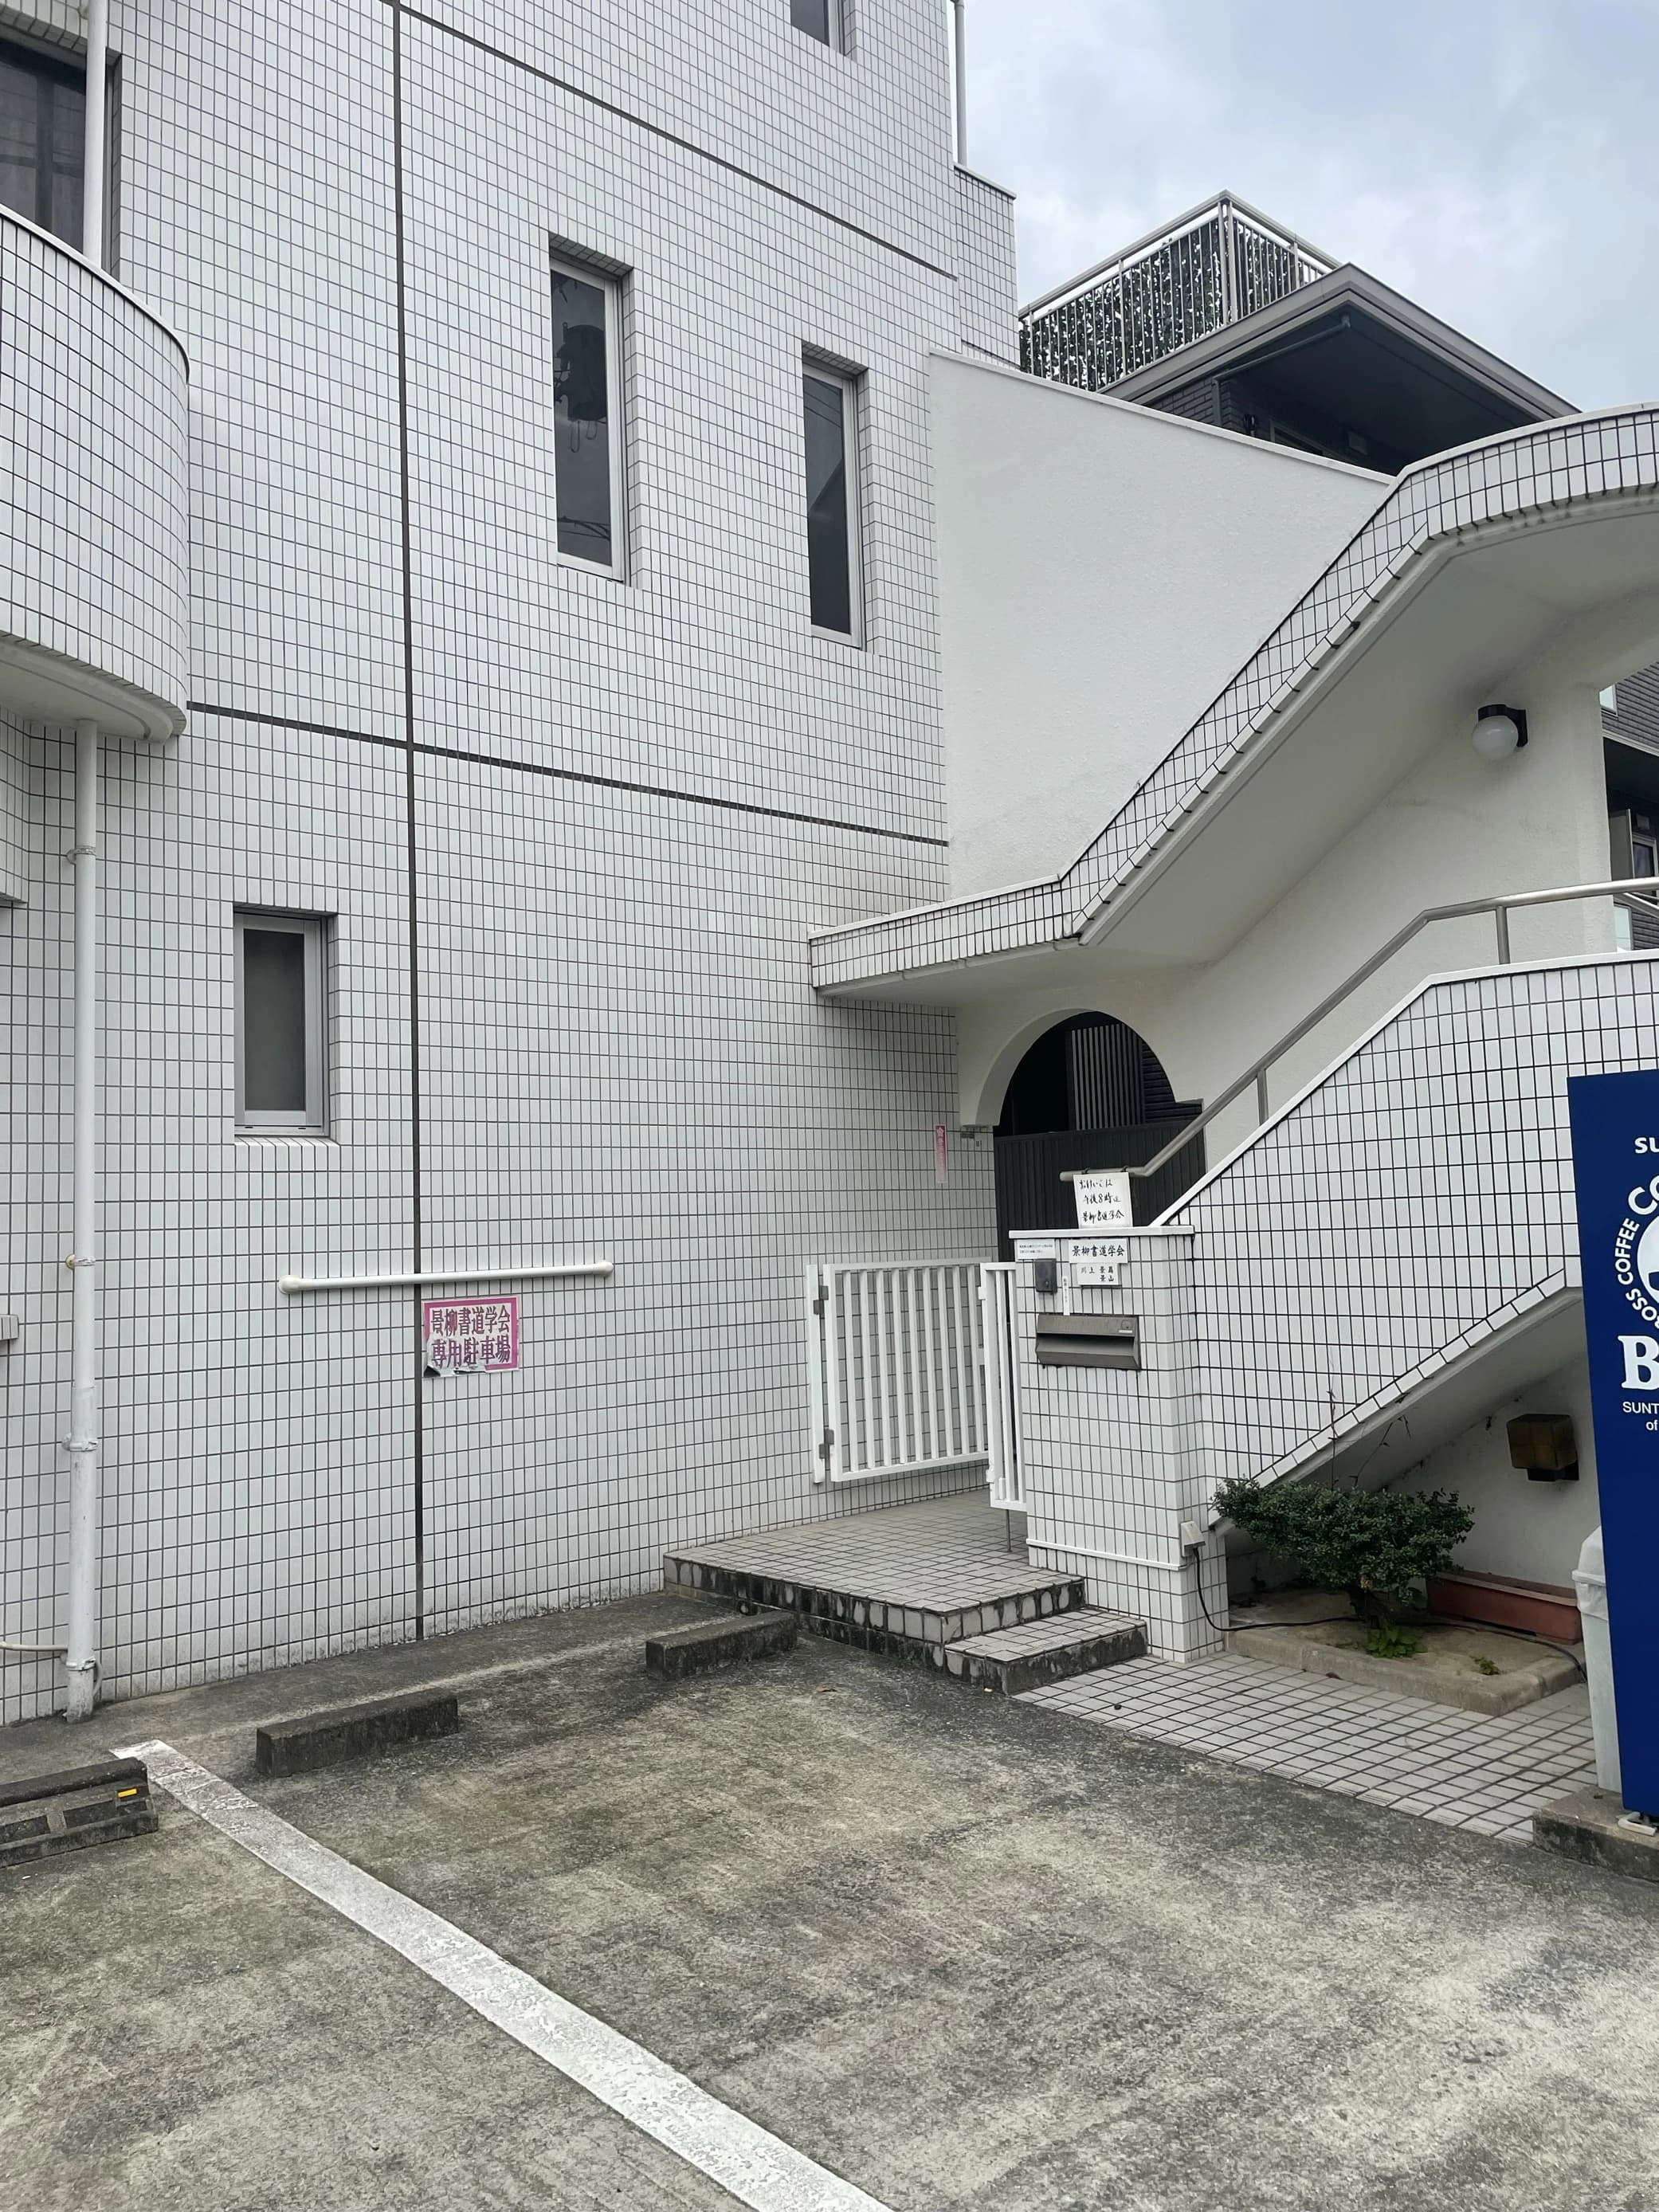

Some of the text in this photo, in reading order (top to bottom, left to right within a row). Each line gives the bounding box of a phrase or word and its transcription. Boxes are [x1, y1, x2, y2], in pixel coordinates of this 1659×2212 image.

[1072, 1245, 1125, 1257] 景柳書道学会
[1614, 1218, 1659, 1330] OSS COFFEE
[430, 1304, 511, 1336] 景柳書道学会
[431, 1334, 511, 1370] 専用駐車場
[1645, 1419, 1658, 1431] of
